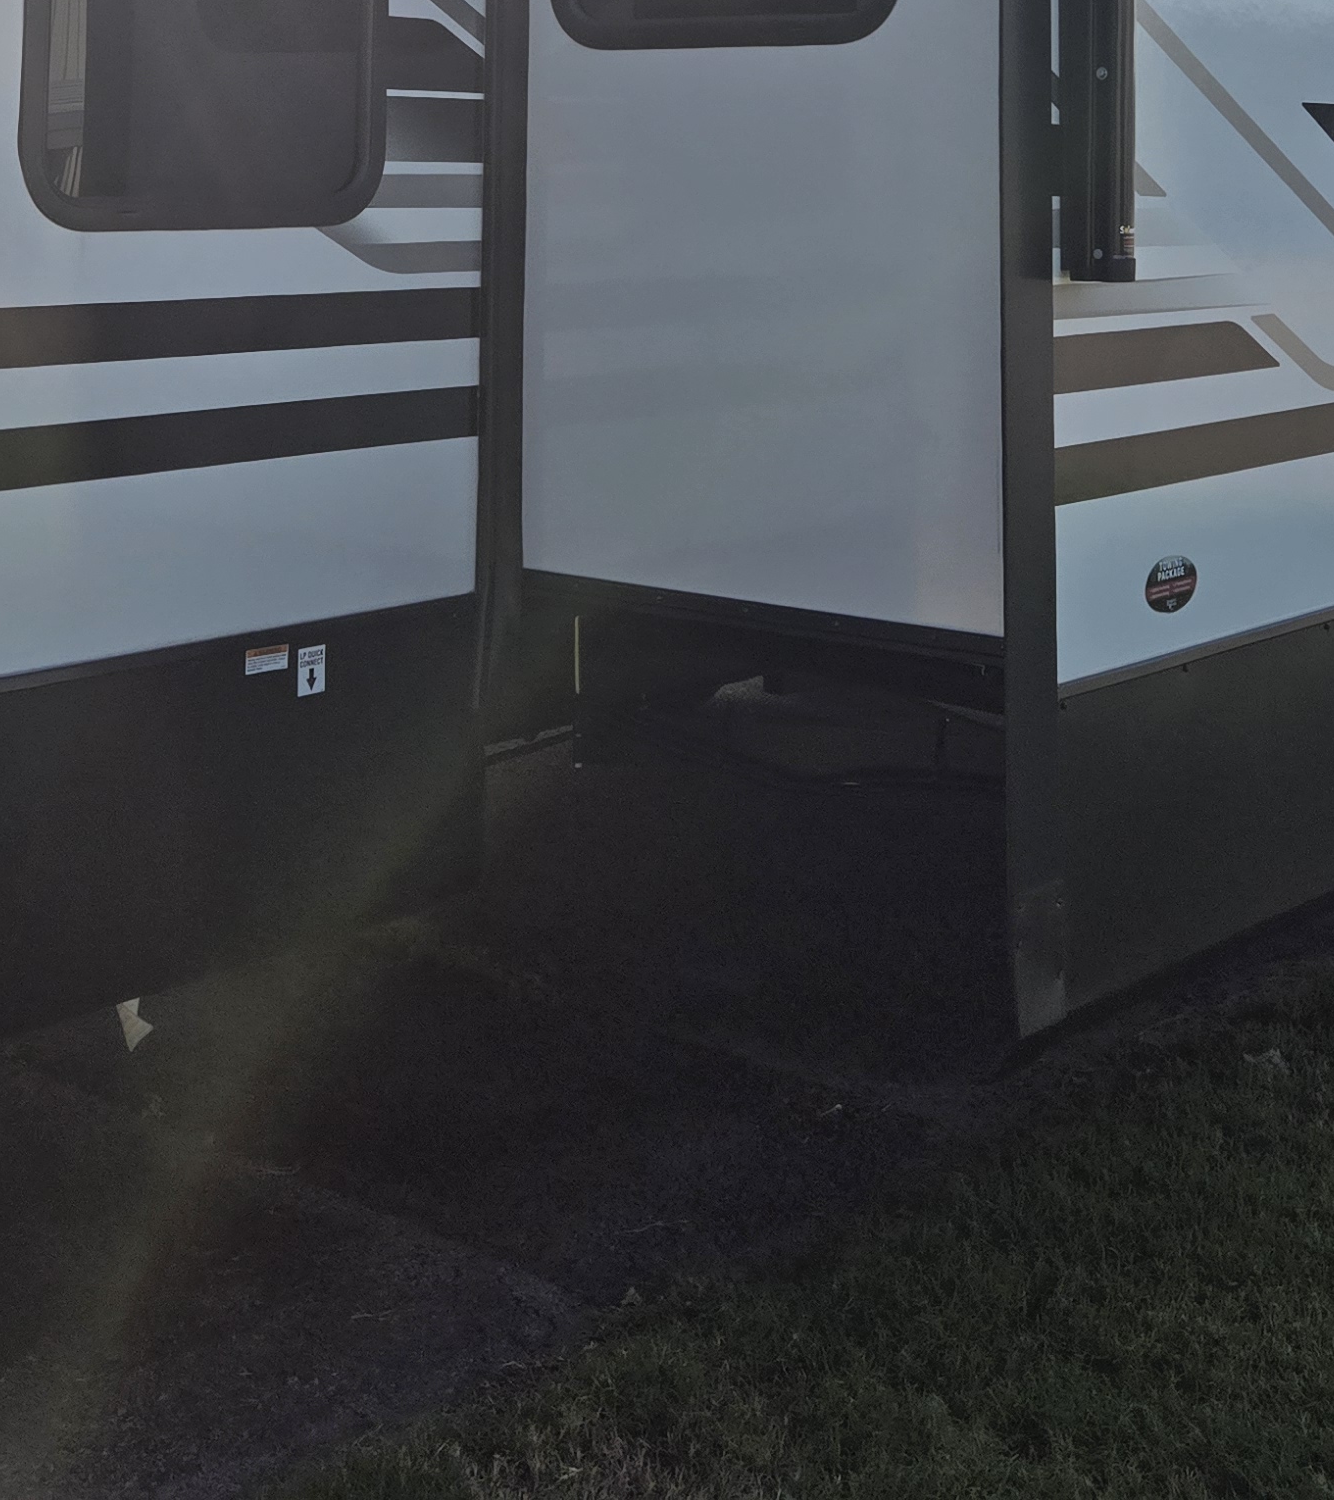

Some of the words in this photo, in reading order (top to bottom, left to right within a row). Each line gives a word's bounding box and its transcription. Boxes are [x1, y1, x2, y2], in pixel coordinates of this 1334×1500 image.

[1158, 557, 1183, 572] TOWING
[1157, 566, 1185, 582] PACKAGE
[299, 652, 307, 661] LP
[307, 648, 324, 659] QUICK
[299, 657, 324, 669] CONNECT
